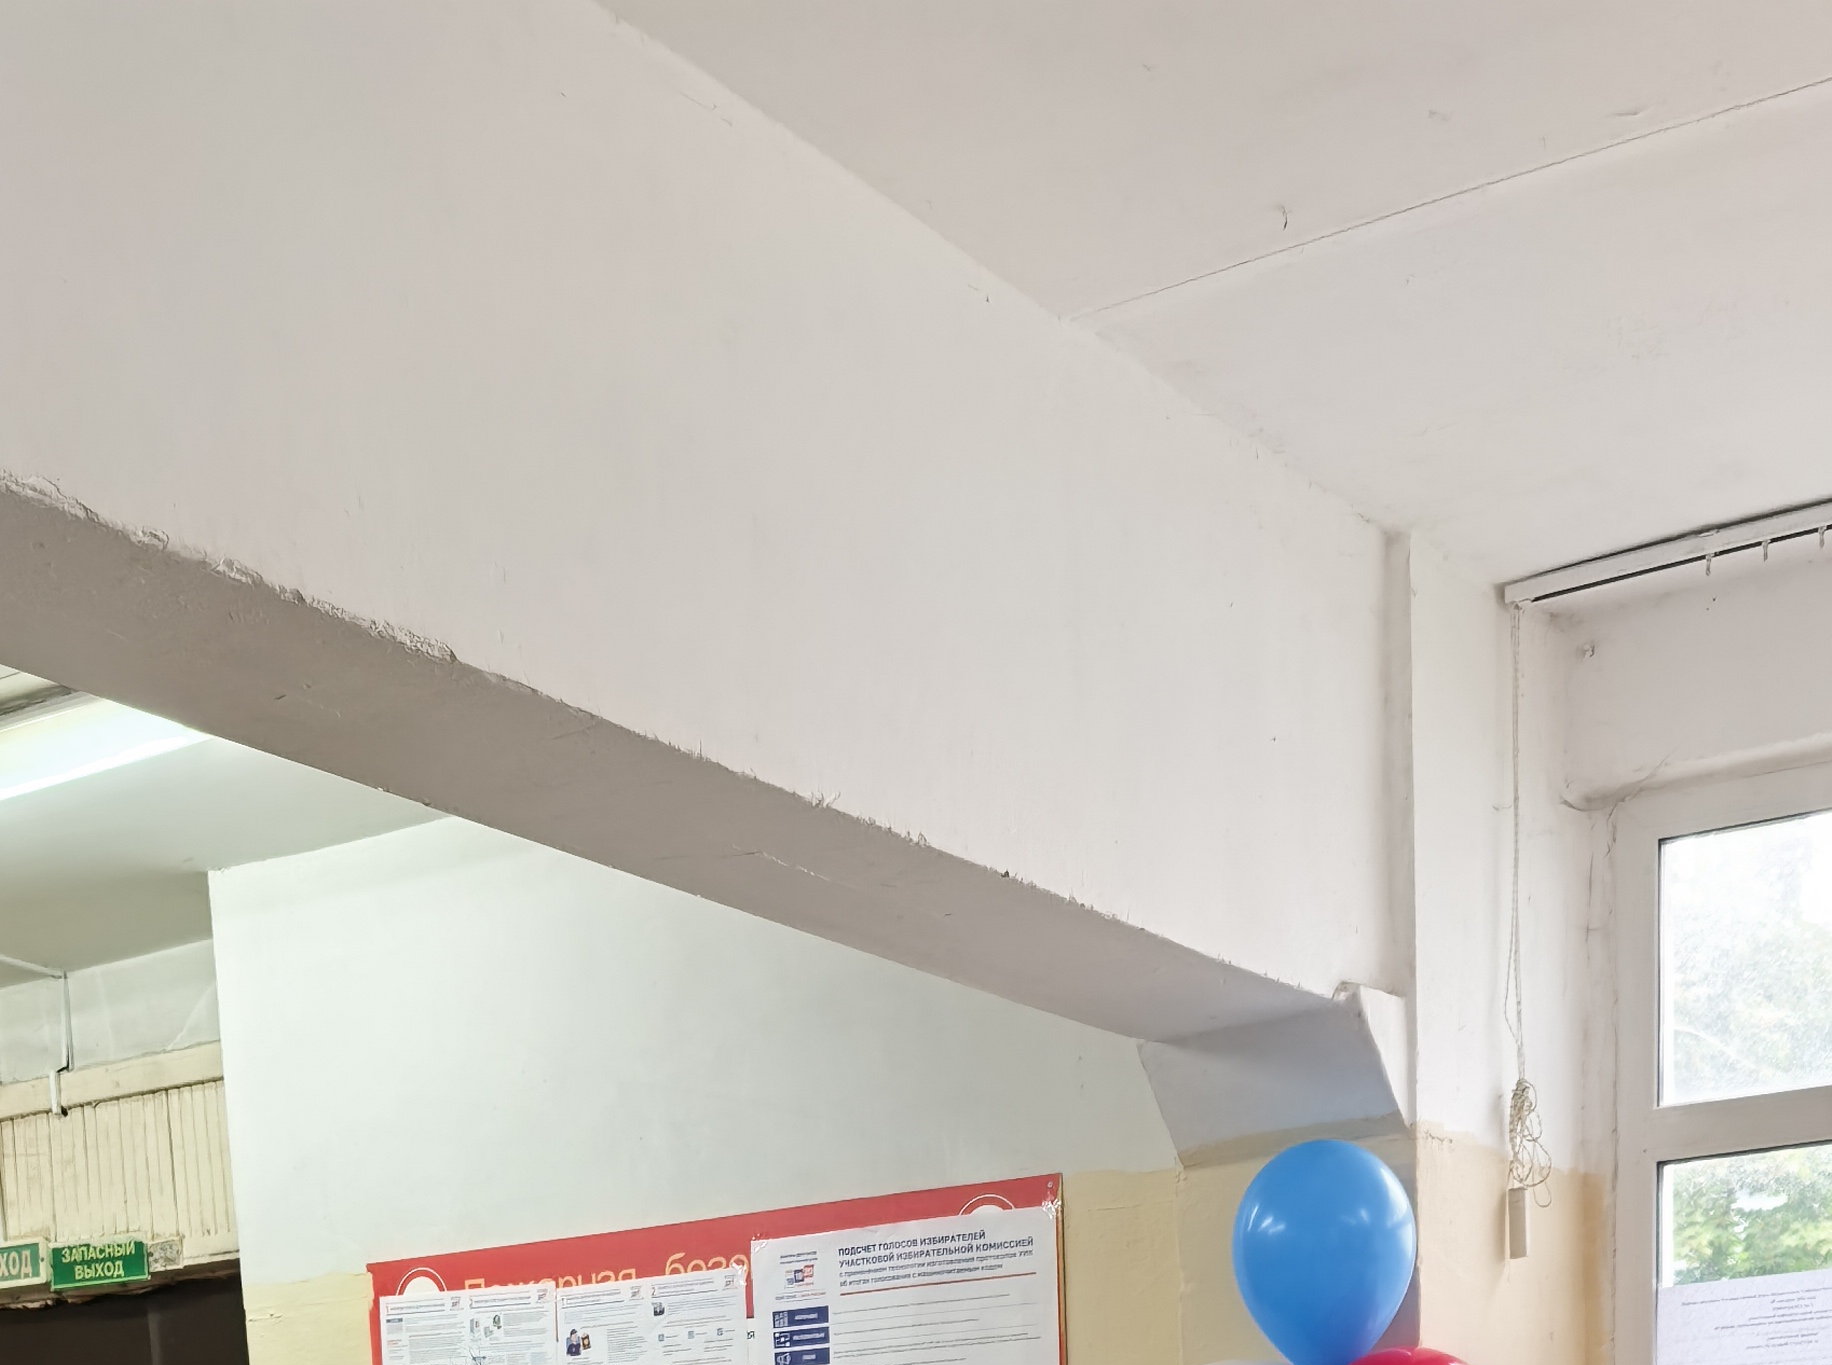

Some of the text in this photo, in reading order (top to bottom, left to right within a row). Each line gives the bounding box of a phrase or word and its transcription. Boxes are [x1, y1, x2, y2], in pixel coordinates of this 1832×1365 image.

[61, 1240, 136, 1263] ЗАПАСНЫЙ
[838, 1229, 986, 1257] ПОДСЧЕТ ГОЛОСОВ ИЗБИРАТЕЛЕЙ
[839, 1236, 1034, 1268] УЧАСТКОВОЙ ИЗБИРАТЕЛЬНОЙ КОМИССИЕЙ
[0, 1250, 32, 1279] ХОД
[74, 1260, 125, 1280] ВЫХОД
